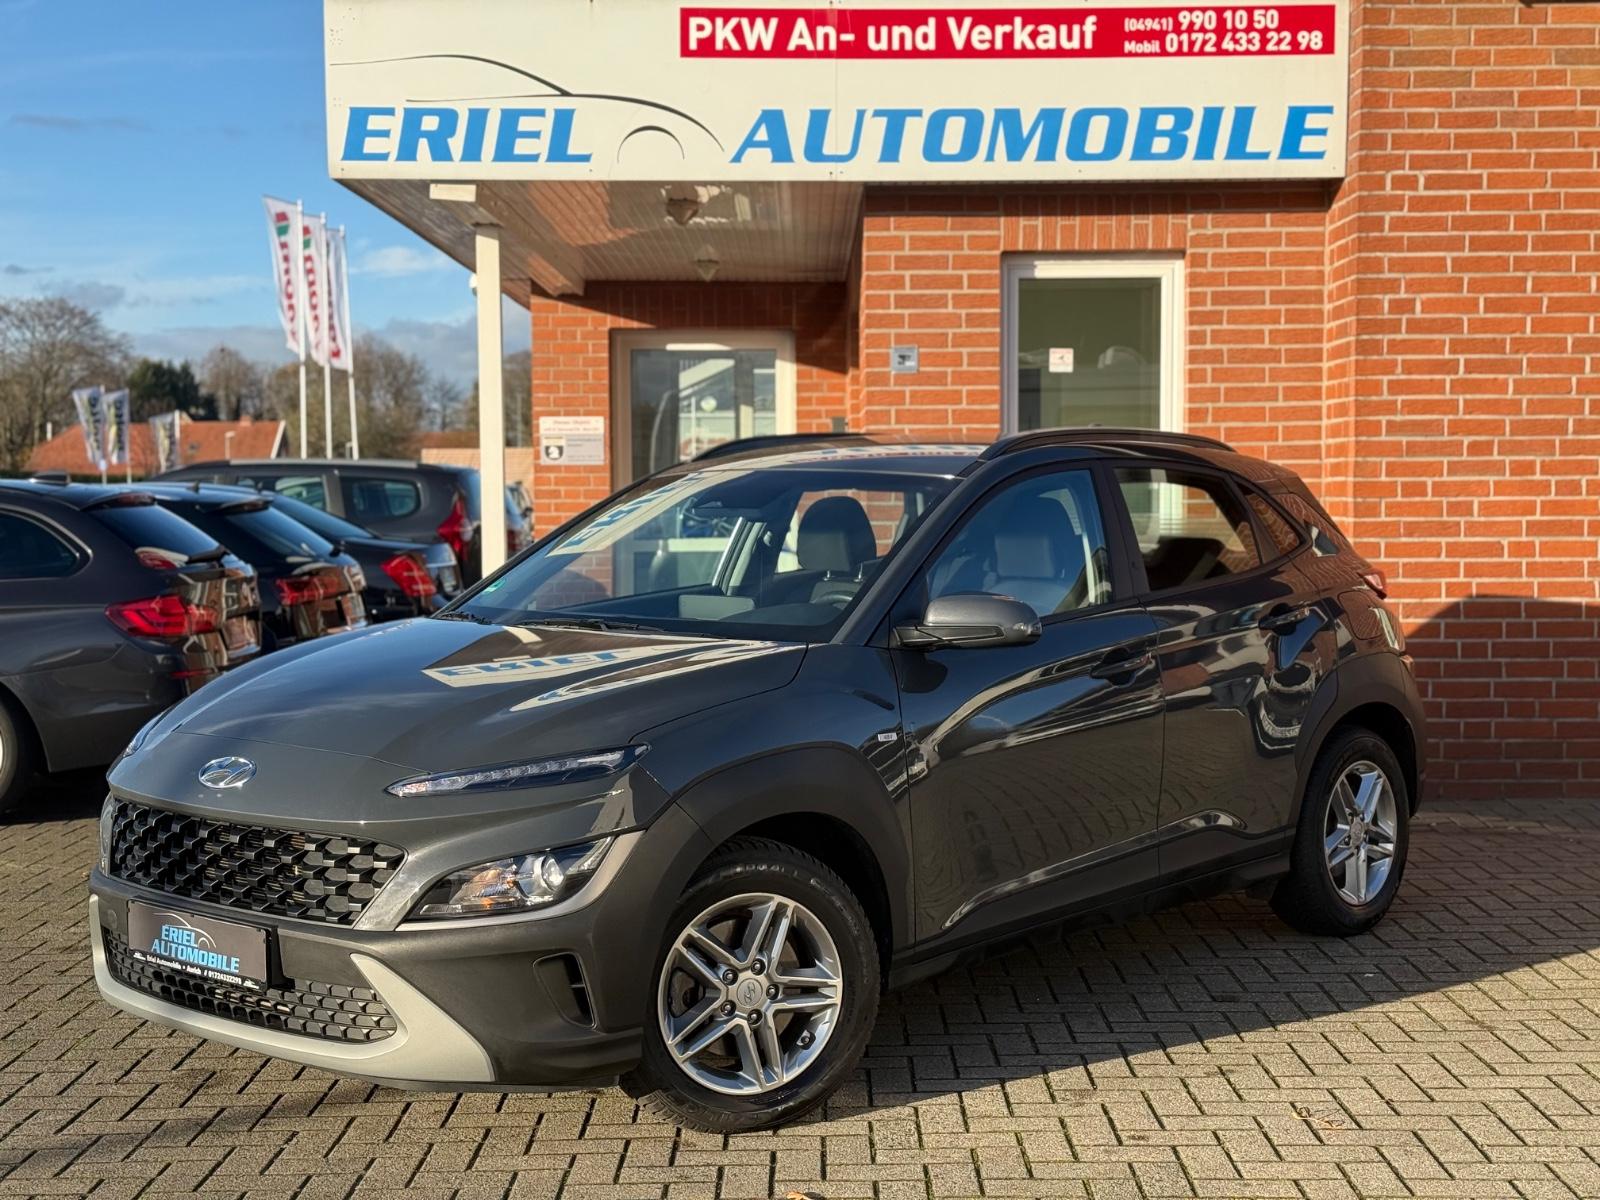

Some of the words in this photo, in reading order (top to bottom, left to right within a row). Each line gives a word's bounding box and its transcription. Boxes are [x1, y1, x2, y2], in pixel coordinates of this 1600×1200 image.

[688, 16, 778, 52] PKW
[787, 15, 856, 50] An-
[868, 17, 936, 51] und
[946, 14, 1098, 50] Verkauf
[1124, 16, 1173, 32] (04941)
[1178, 10, 1217, 31] 990
[1222, 10, 1249, 31] 10
[1253, 9, 1279, 29] 50
[1123, 38, 1161, 55] Mobil
[1165, 33, 1217, 53] 0172
[1221, 32, 1259, 53] 433
[1265, 32, 1292, 52] 22
[1296, 30, 1324, 52] 98
[341, 106, 593, 163] ERIEL
[729, 105, 1334, 163] AUTOMOBILE
[161, 925, 198, 947] ERIEL
[151, 938, 240, 973] AUTOMOBILE
